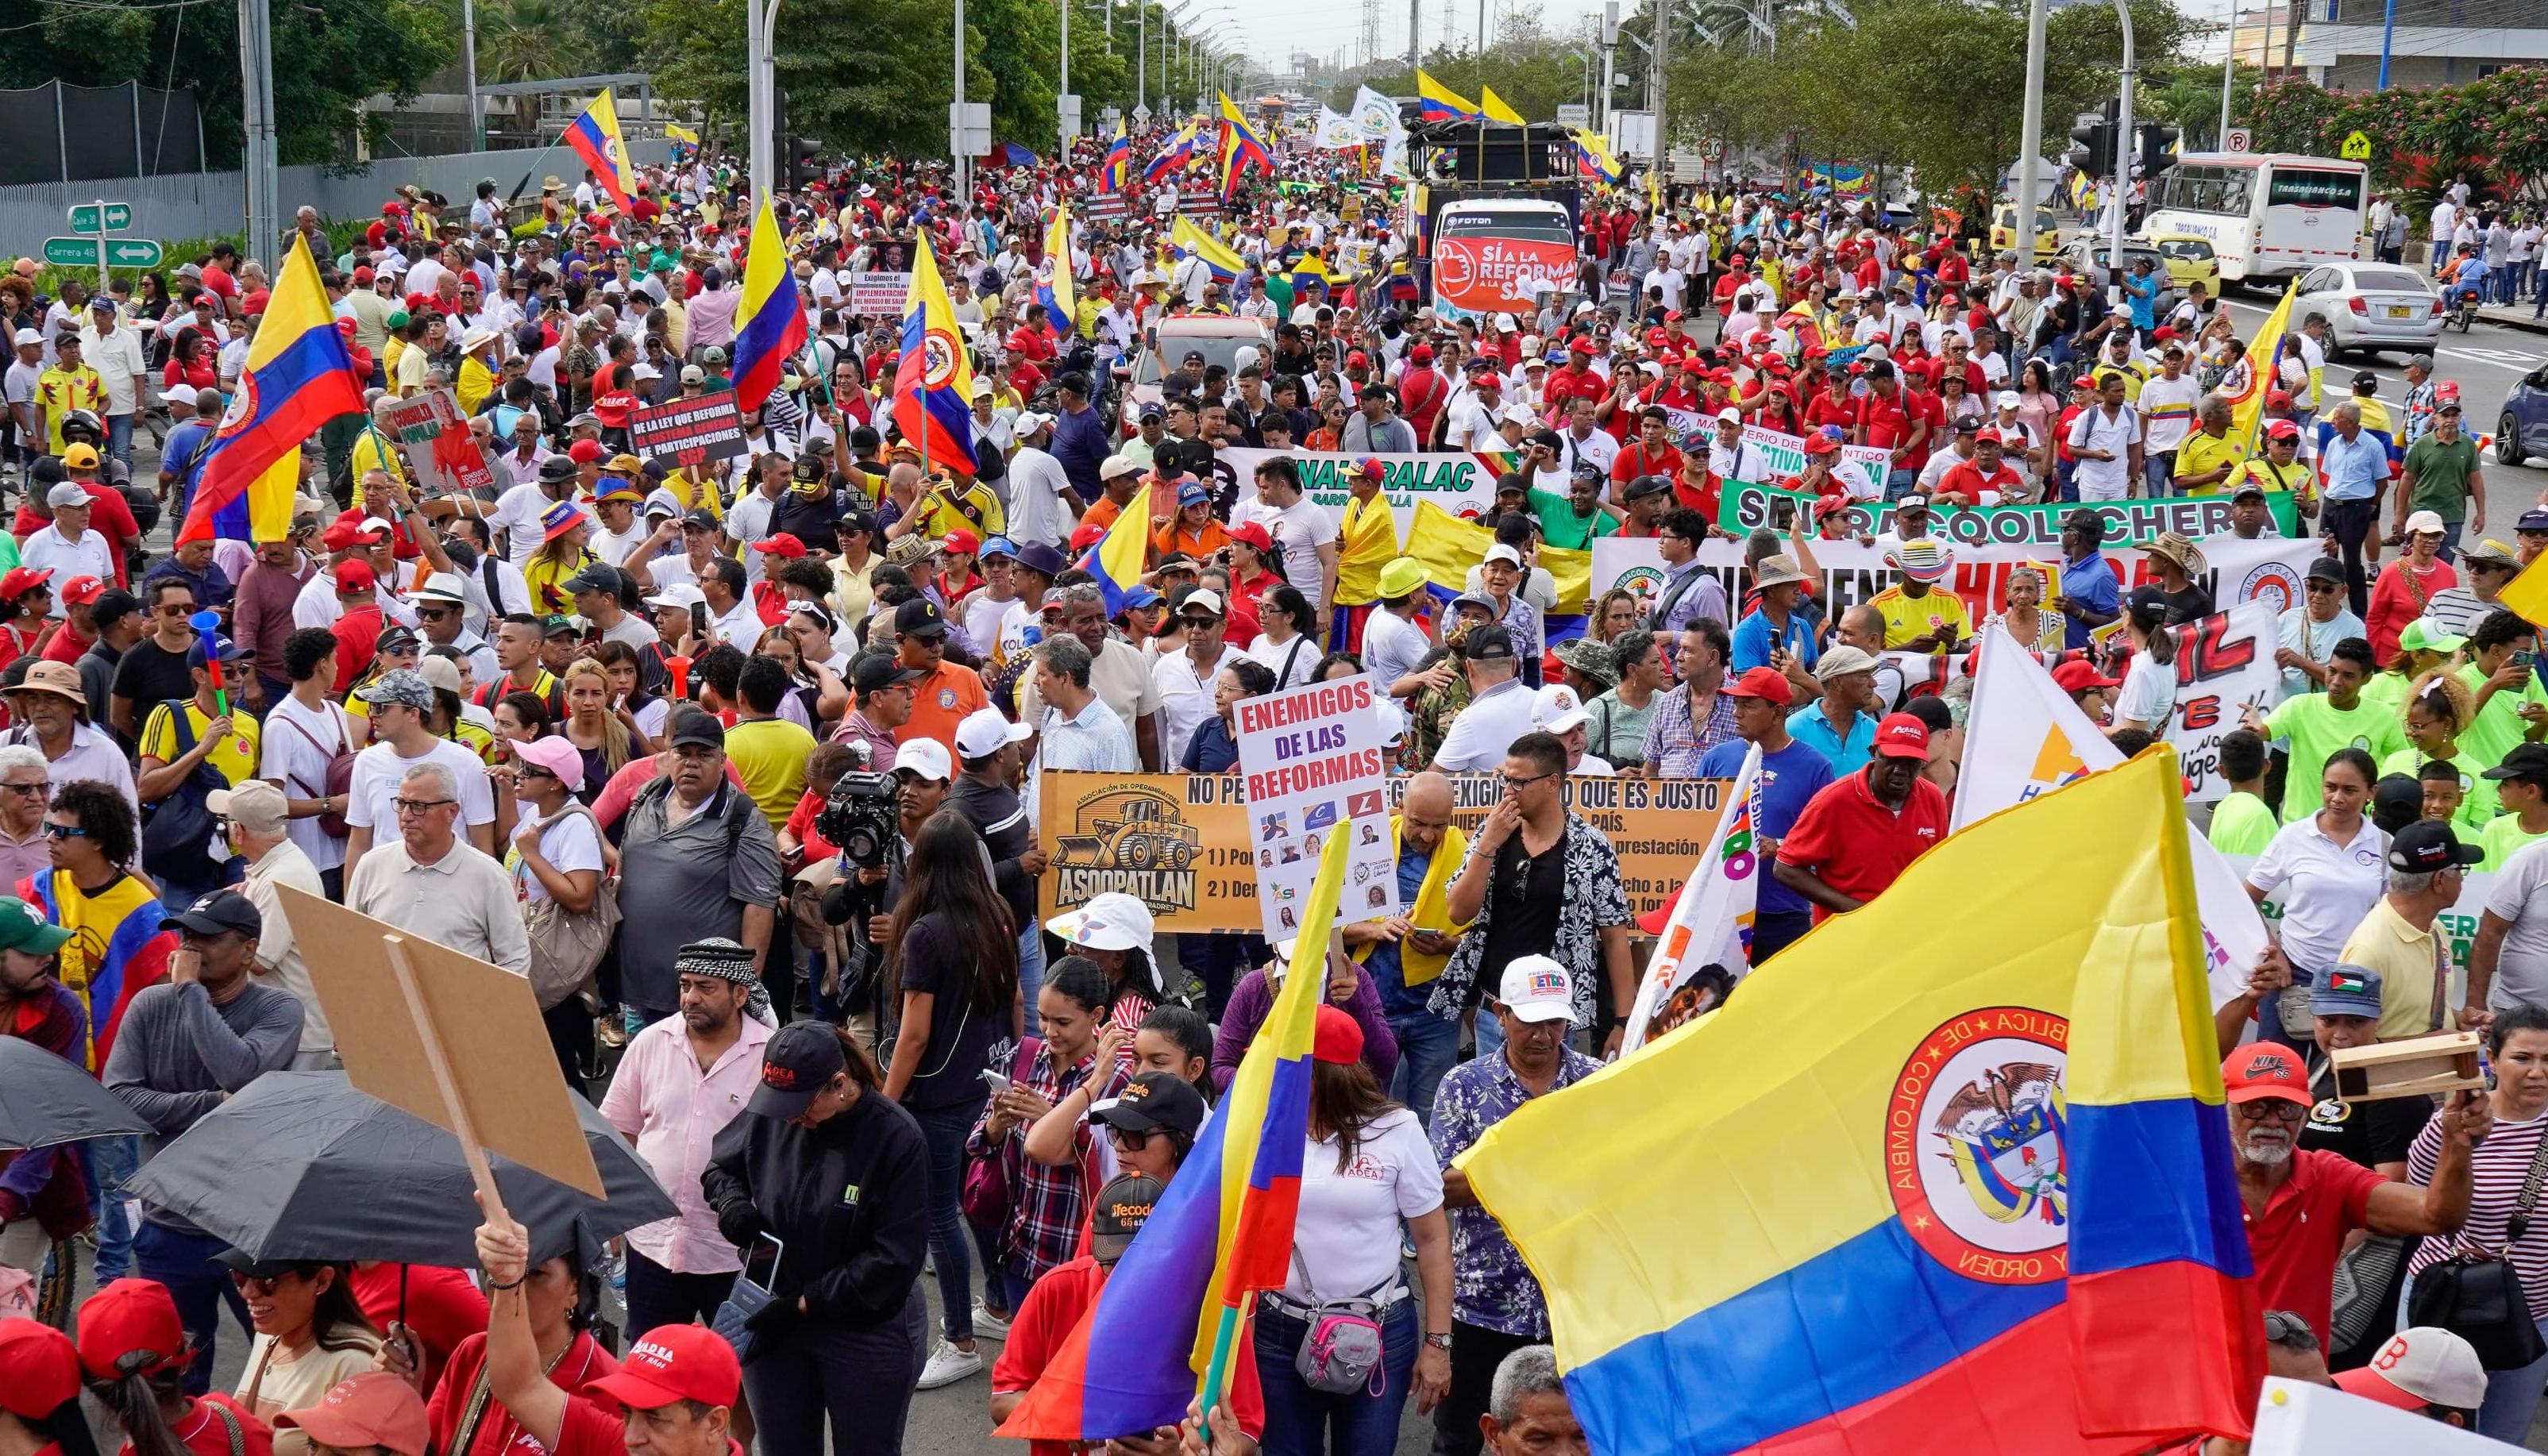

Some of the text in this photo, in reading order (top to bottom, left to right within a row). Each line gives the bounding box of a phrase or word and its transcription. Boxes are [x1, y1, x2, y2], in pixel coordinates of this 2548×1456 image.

[73, 216, 87, 225] Calle
[48, 247, 81, 256] Carrera
[1482, 242, 1539, 262] SÍ A LA
[1480, 260, 1575, 280] REFORMA
[634, 403, 736, 434] DE LA LEY QUE REFORMA
[639, 426, 741, 457] DE PARTICIPACIONES
[547, 507, 569, 526] COLOMBIA
[1241, 681, 1370, 734] ENEMIGOS
[1275, 723, 1346, 761] DE LAS
[1248, 749, 1381, 802] REFORMAS
[1188, 776, 1214, 805] NO
[1580, 781, 1617, 810] QUE
[1624, 781, 1648, 809] ES
[1655, 782, 1718, 811] JUSTO
[1616, 838, 1699, 857] prestación
[1058, 869, 1194, 909] ASOOPATLAN
[1274, 888, 1295, 901] ASI
[1529, 974, 1565, 988] PETRO
[2251, 1055, 2285, 1067] NIKE
[2275, 1069, 2291, 1080] SB
[2306, 1121, 2343, 1133] Atlántico
[1347, 1169, 1378, 1180] ADEA
[1120, 1217, 1133, 1227] 65
[2374, 1335, 2409, 1370] B
